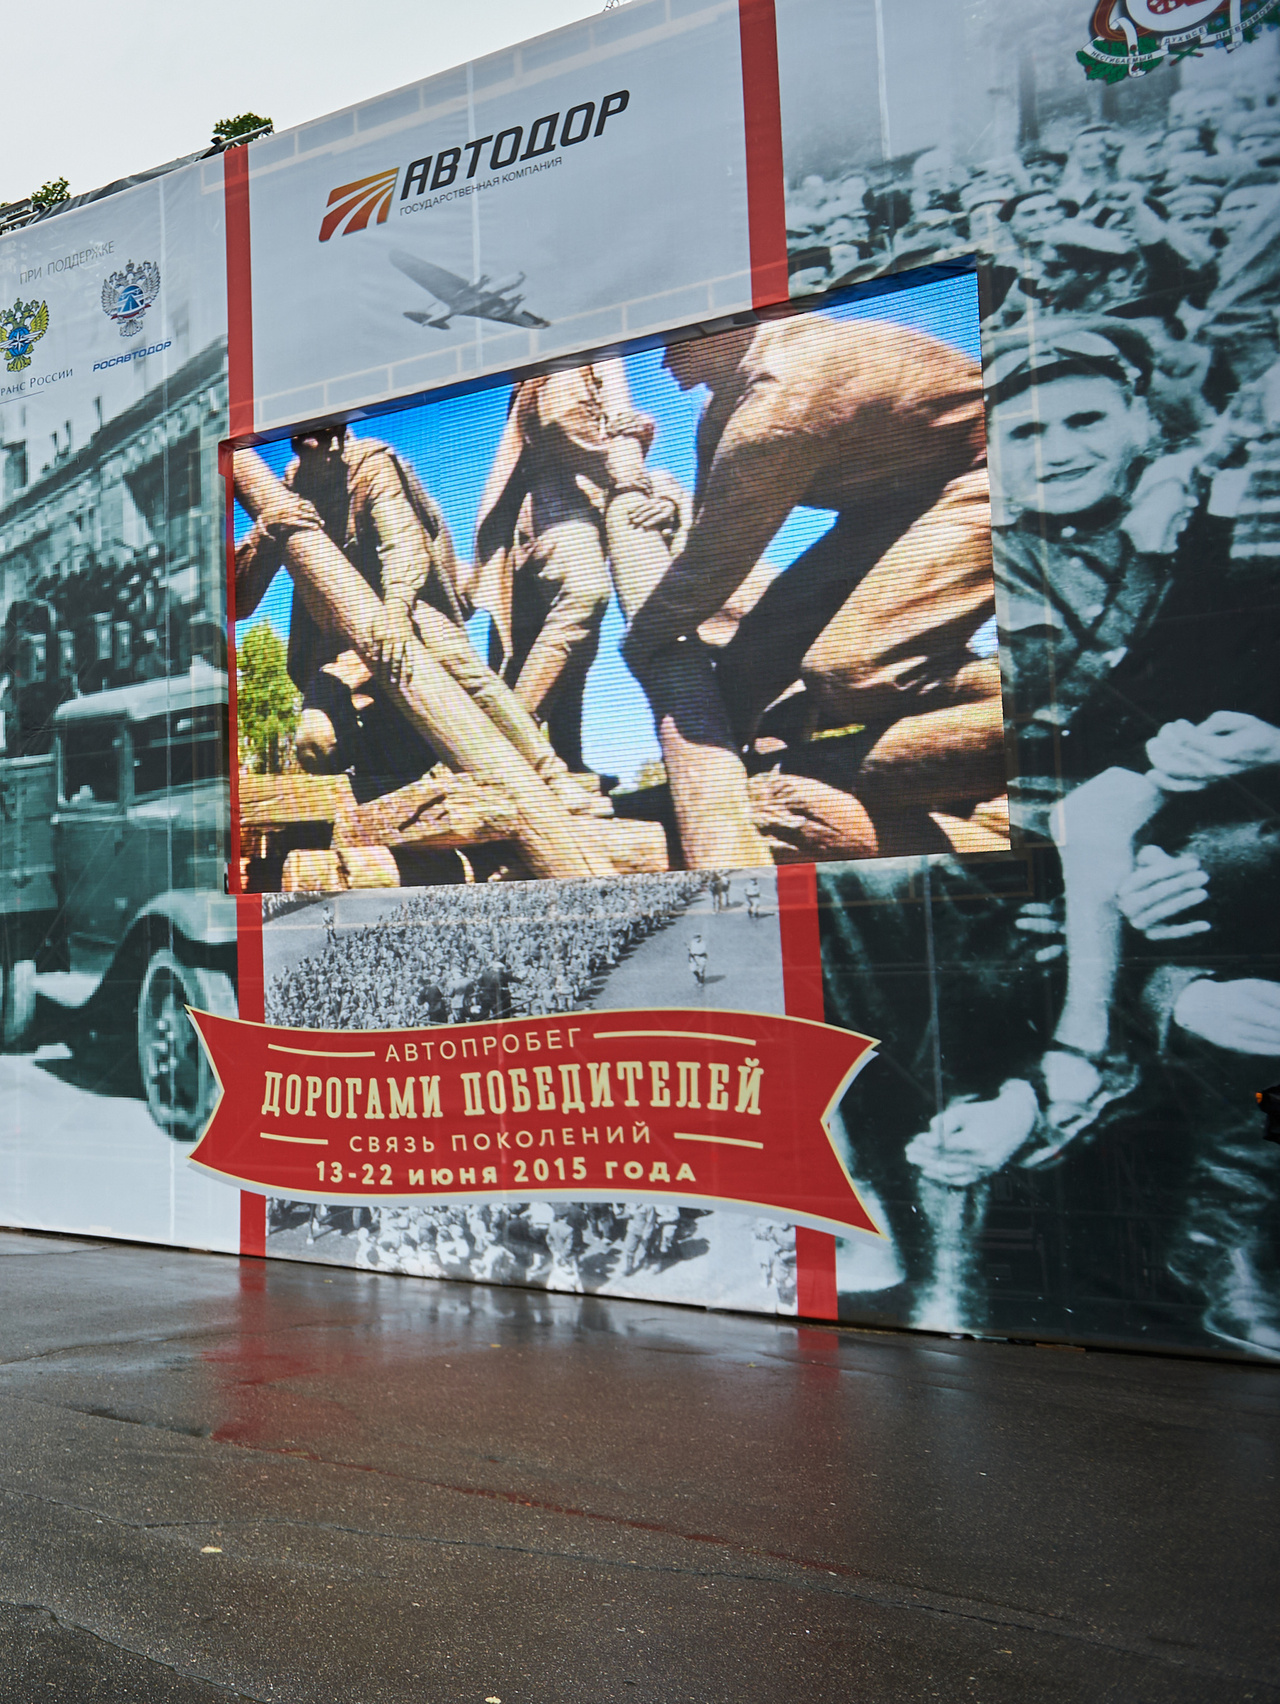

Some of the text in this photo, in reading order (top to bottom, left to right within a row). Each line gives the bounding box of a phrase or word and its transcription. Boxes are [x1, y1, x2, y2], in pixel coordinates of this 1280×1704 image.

[400, 89, 630, 201] АВТОДОР
[400, 156, 563, 216] ГОСУДАРСТВЕННАЯ КОМПАНИЯ
[20, 240, 115, 285] ПРИ ПОДДЕРЖКЕ
[92, 341, 172, 372] РОСАВТОДОР
[385, 1028, 581, 1062] АВТОПРОБЕГ
[261, 1057, 764, 1119] ДОРОГАМИ ПОБЕДИТЕЛЕЙ
[349, 1121, 650, 1153] СВЯЗЬ ПОКОЛЕНИЙ
[316, 1160, 393, 1185] 13-22
[513, 1157, 587, 1182] 2015
